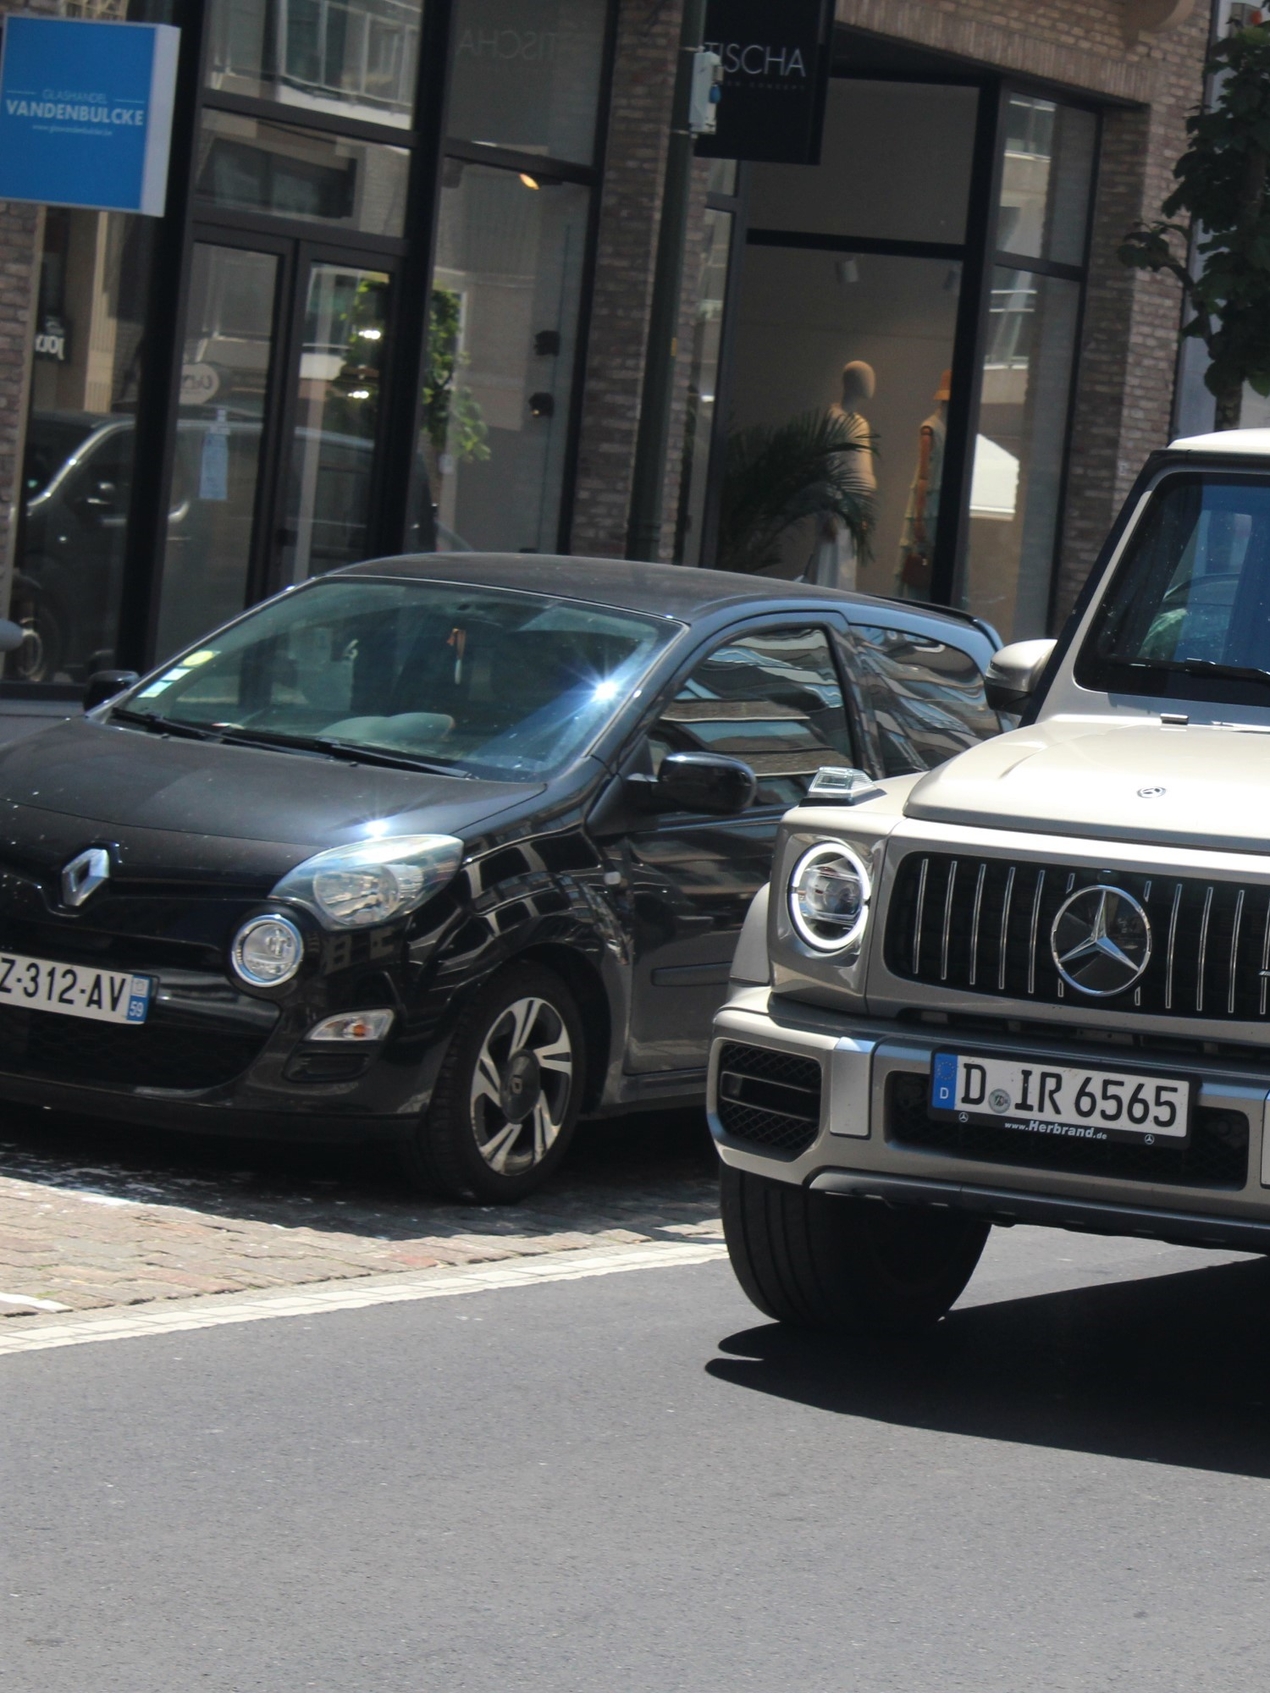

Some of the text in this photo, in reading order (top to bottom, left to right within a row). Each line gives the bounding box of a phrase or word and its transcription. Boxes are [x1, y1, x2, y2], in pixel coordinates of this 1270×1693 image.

[6, 99, 145, 126] VANDENBULCKE
[129, 1001, 144, 1018] 59
[939, 1087, 949, 1100] D
[961, 1062, 1179, 1128] D IR 6565
[1004, 1120, 1108, 1140] www.Herbrand.de
